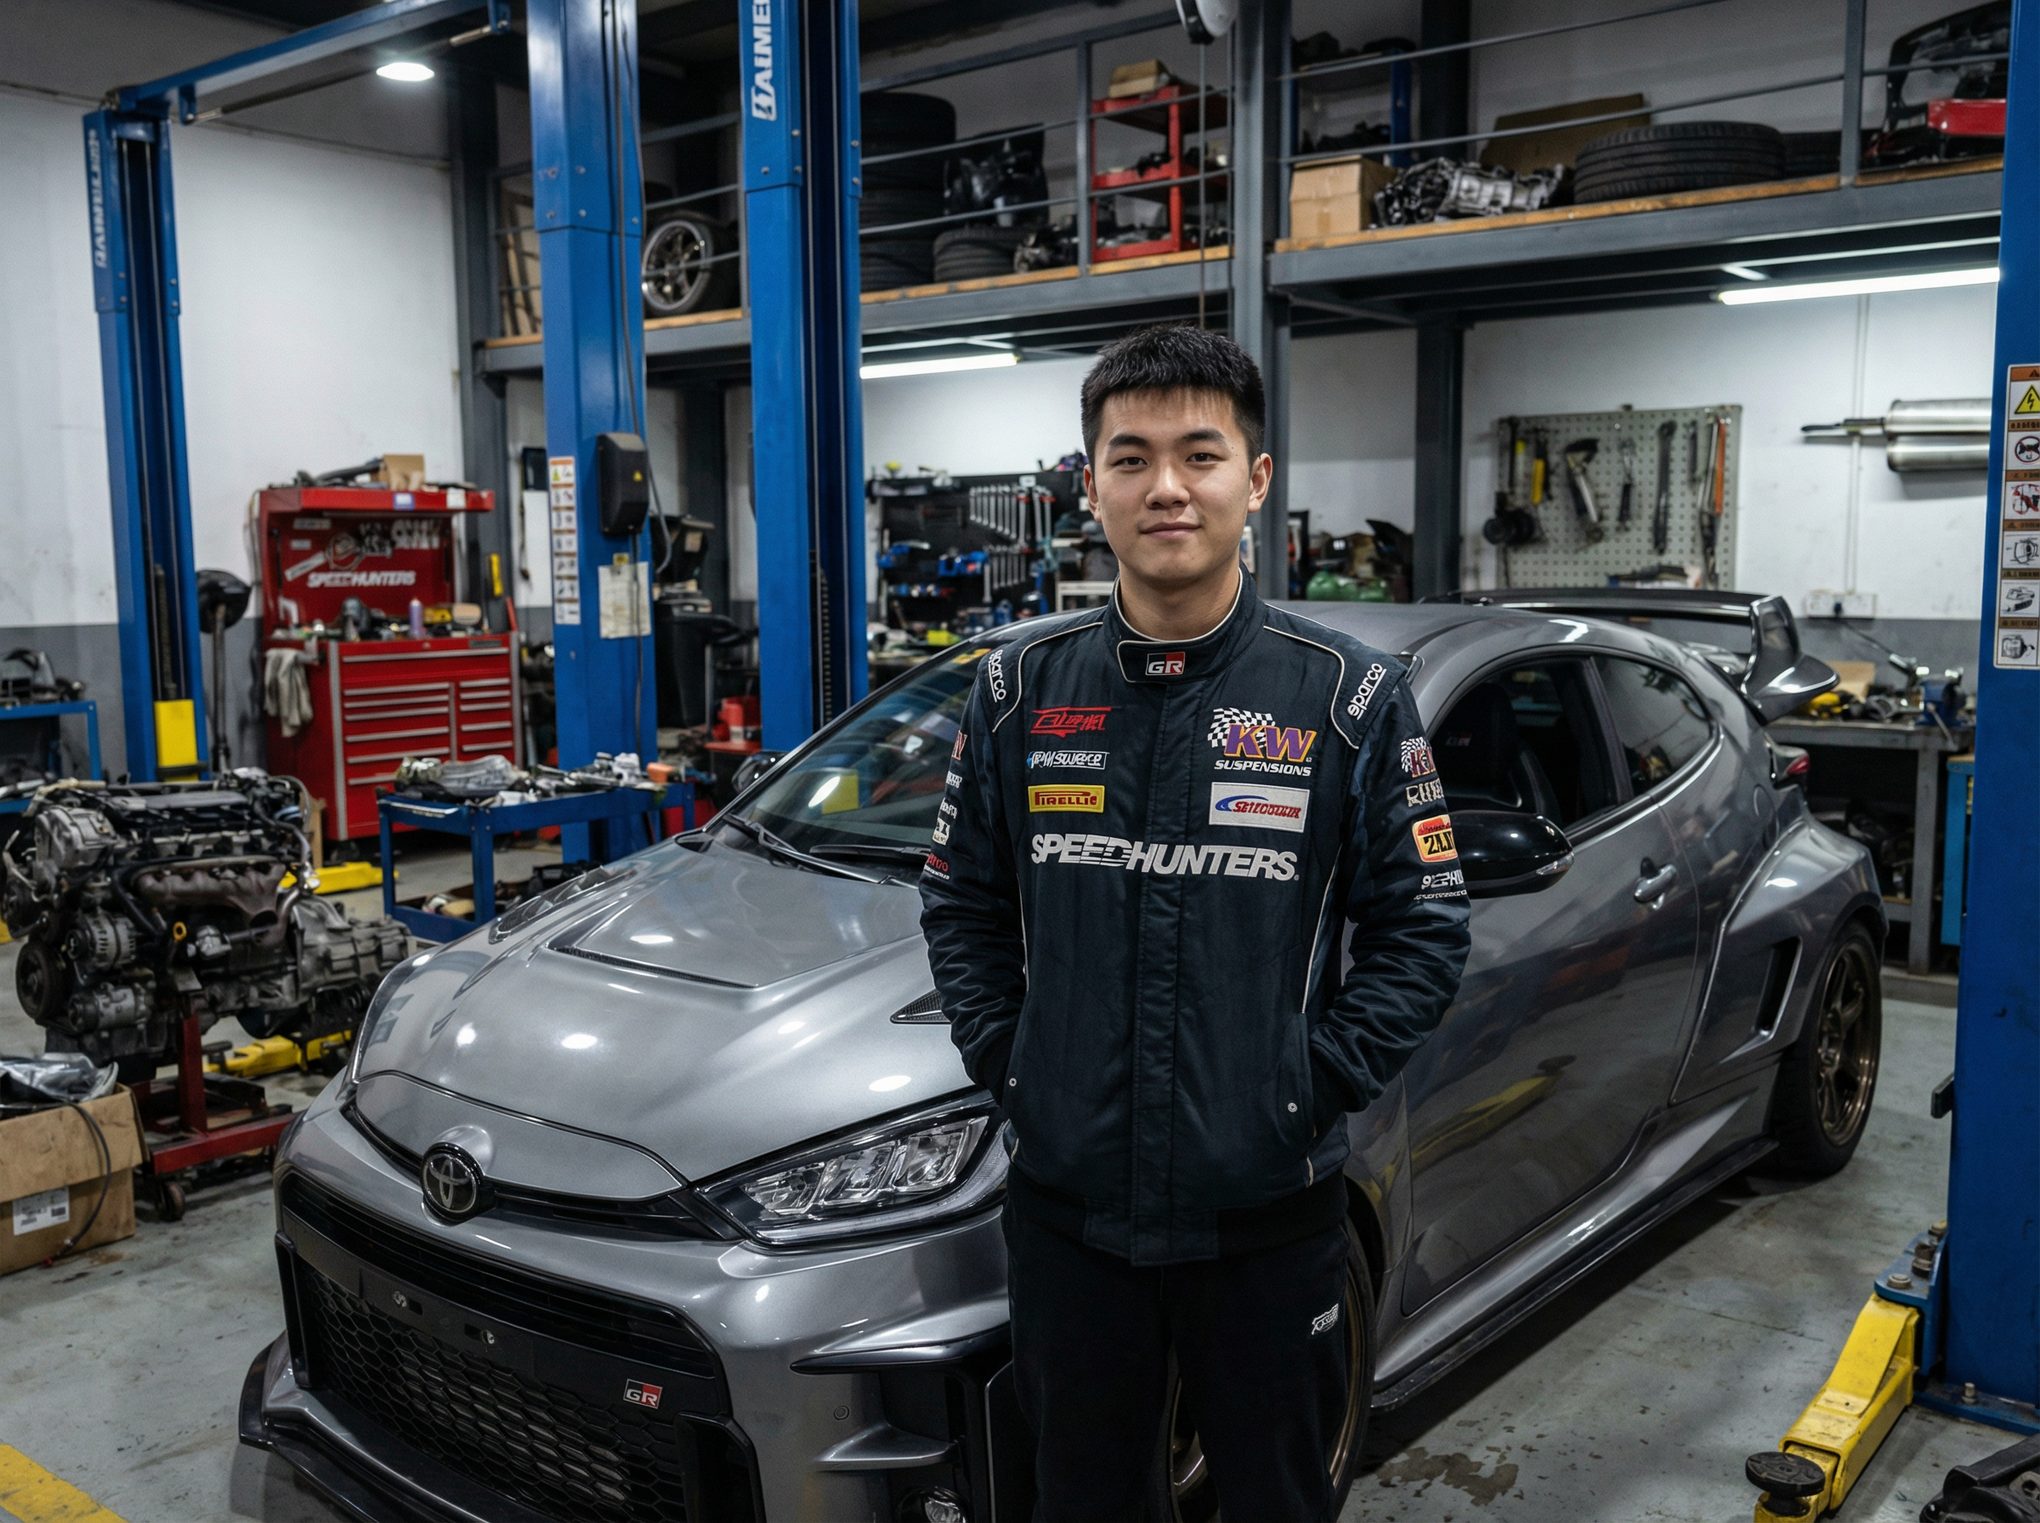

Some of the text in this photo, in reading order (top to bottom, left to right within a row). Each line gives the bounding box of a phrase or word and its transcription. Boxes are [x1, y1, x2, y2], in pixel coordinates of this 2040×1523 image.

[1148, 660, 1183, 674] GR
[1223, 723, 1318, 763] KW
[1213, 759, 1312, 777] SUSPENSIONS
[1030, 833, 1299, 882] SPEEDHUNTERS
[626, 1388, 658, 1406] GR
